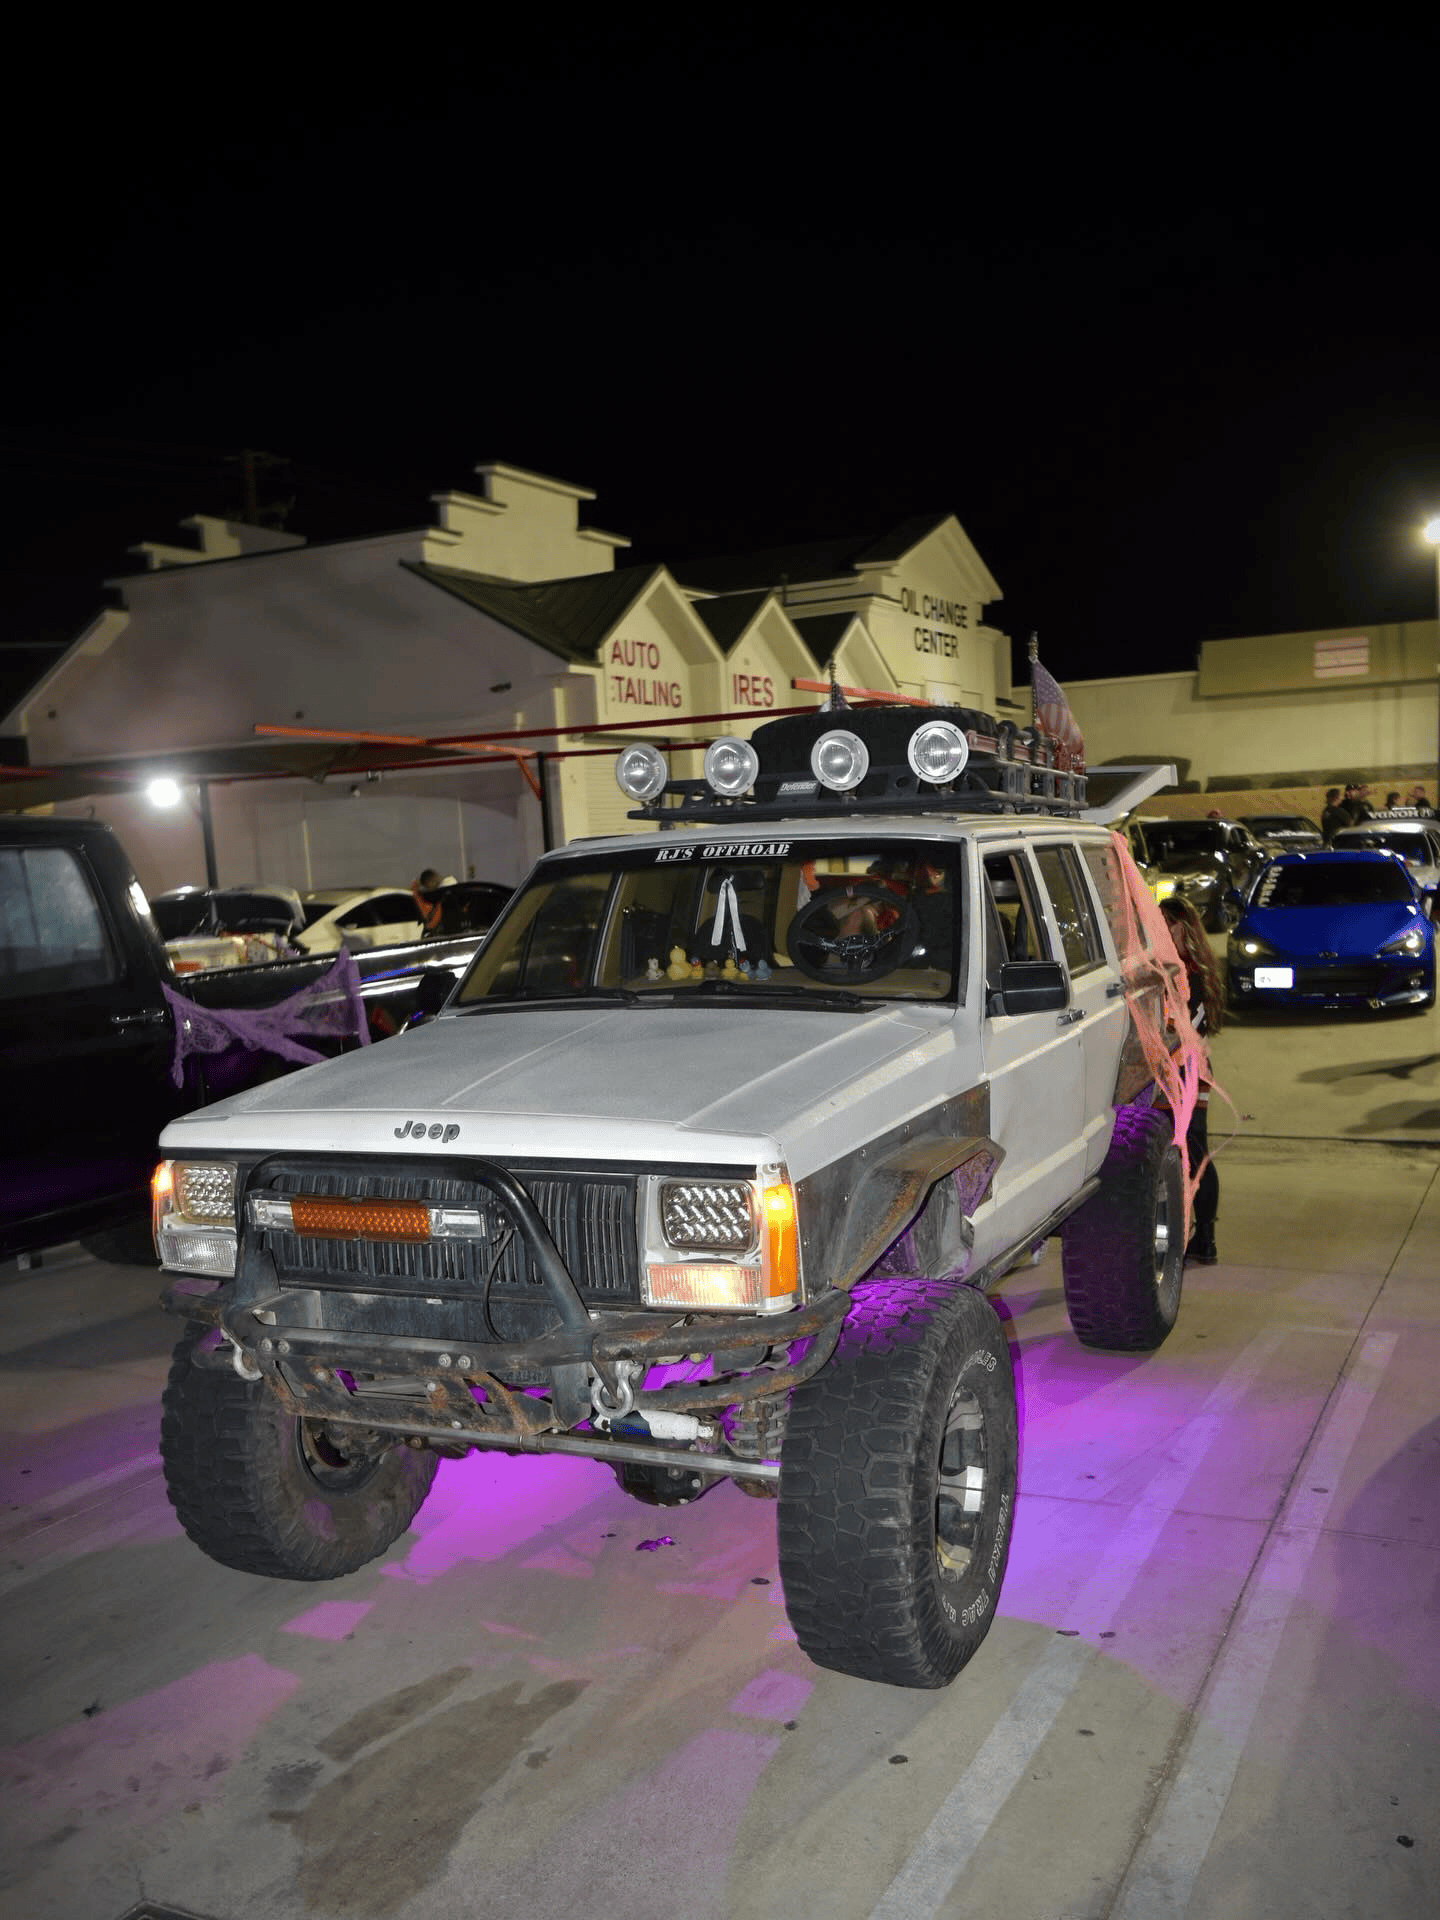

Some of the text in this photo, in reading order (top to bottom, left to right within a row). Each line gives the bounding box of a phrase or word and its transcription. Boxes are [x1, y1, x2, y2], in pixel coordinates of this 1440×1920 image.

[901, 587, 968, 629] OIL CHANGE
[610, 639, 661, 670] AUTO
[914, 627, 959, 658] CENTER
[610, 675, 683, 708] TAILING
[732, 673, 774, 708] IRES
[655, 842, 791, 862] RJ'S OFFROAD
[393, 1120, 461, 1144] Jeep
